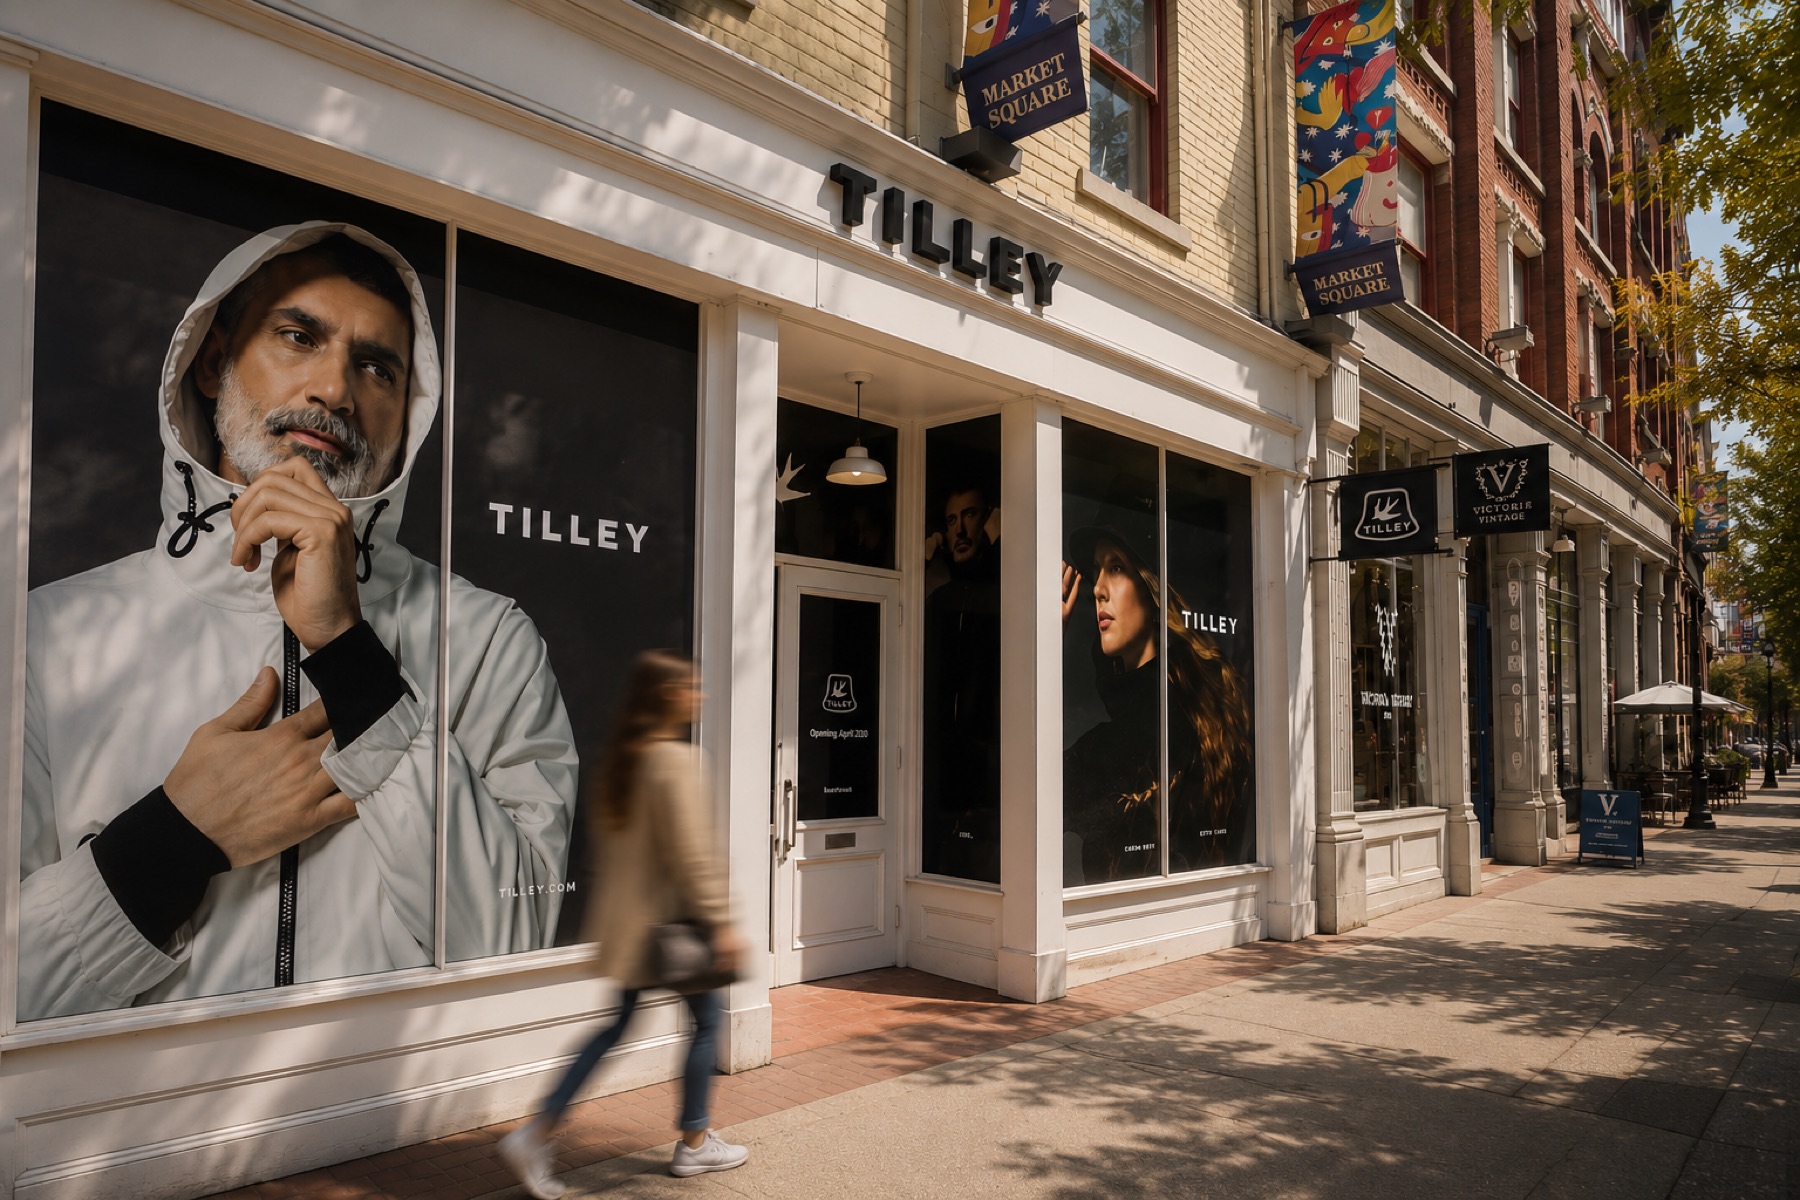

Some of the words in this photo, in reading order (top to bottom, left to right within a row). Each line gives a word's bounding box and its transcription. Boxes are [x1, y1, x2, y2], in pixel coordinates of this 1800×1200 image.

[981, 52, 1065, 107] MARKET
[988, 77, 1072, 129] SQUARE
[830, 163, 1063, 306] TILLEY
[1312, 261, 1384, 291] MARKET
[1319, 277, 1391, 306] SQUARE
[488, 501, 649, 554] TILLEY
[1363, 521, 1411, 534] TILLEY
[1181, 609, 1238, 635] TILLEY
[810, 728, 838, 740] Opening
[498, 881, 576, 899] TILLEY.COM
